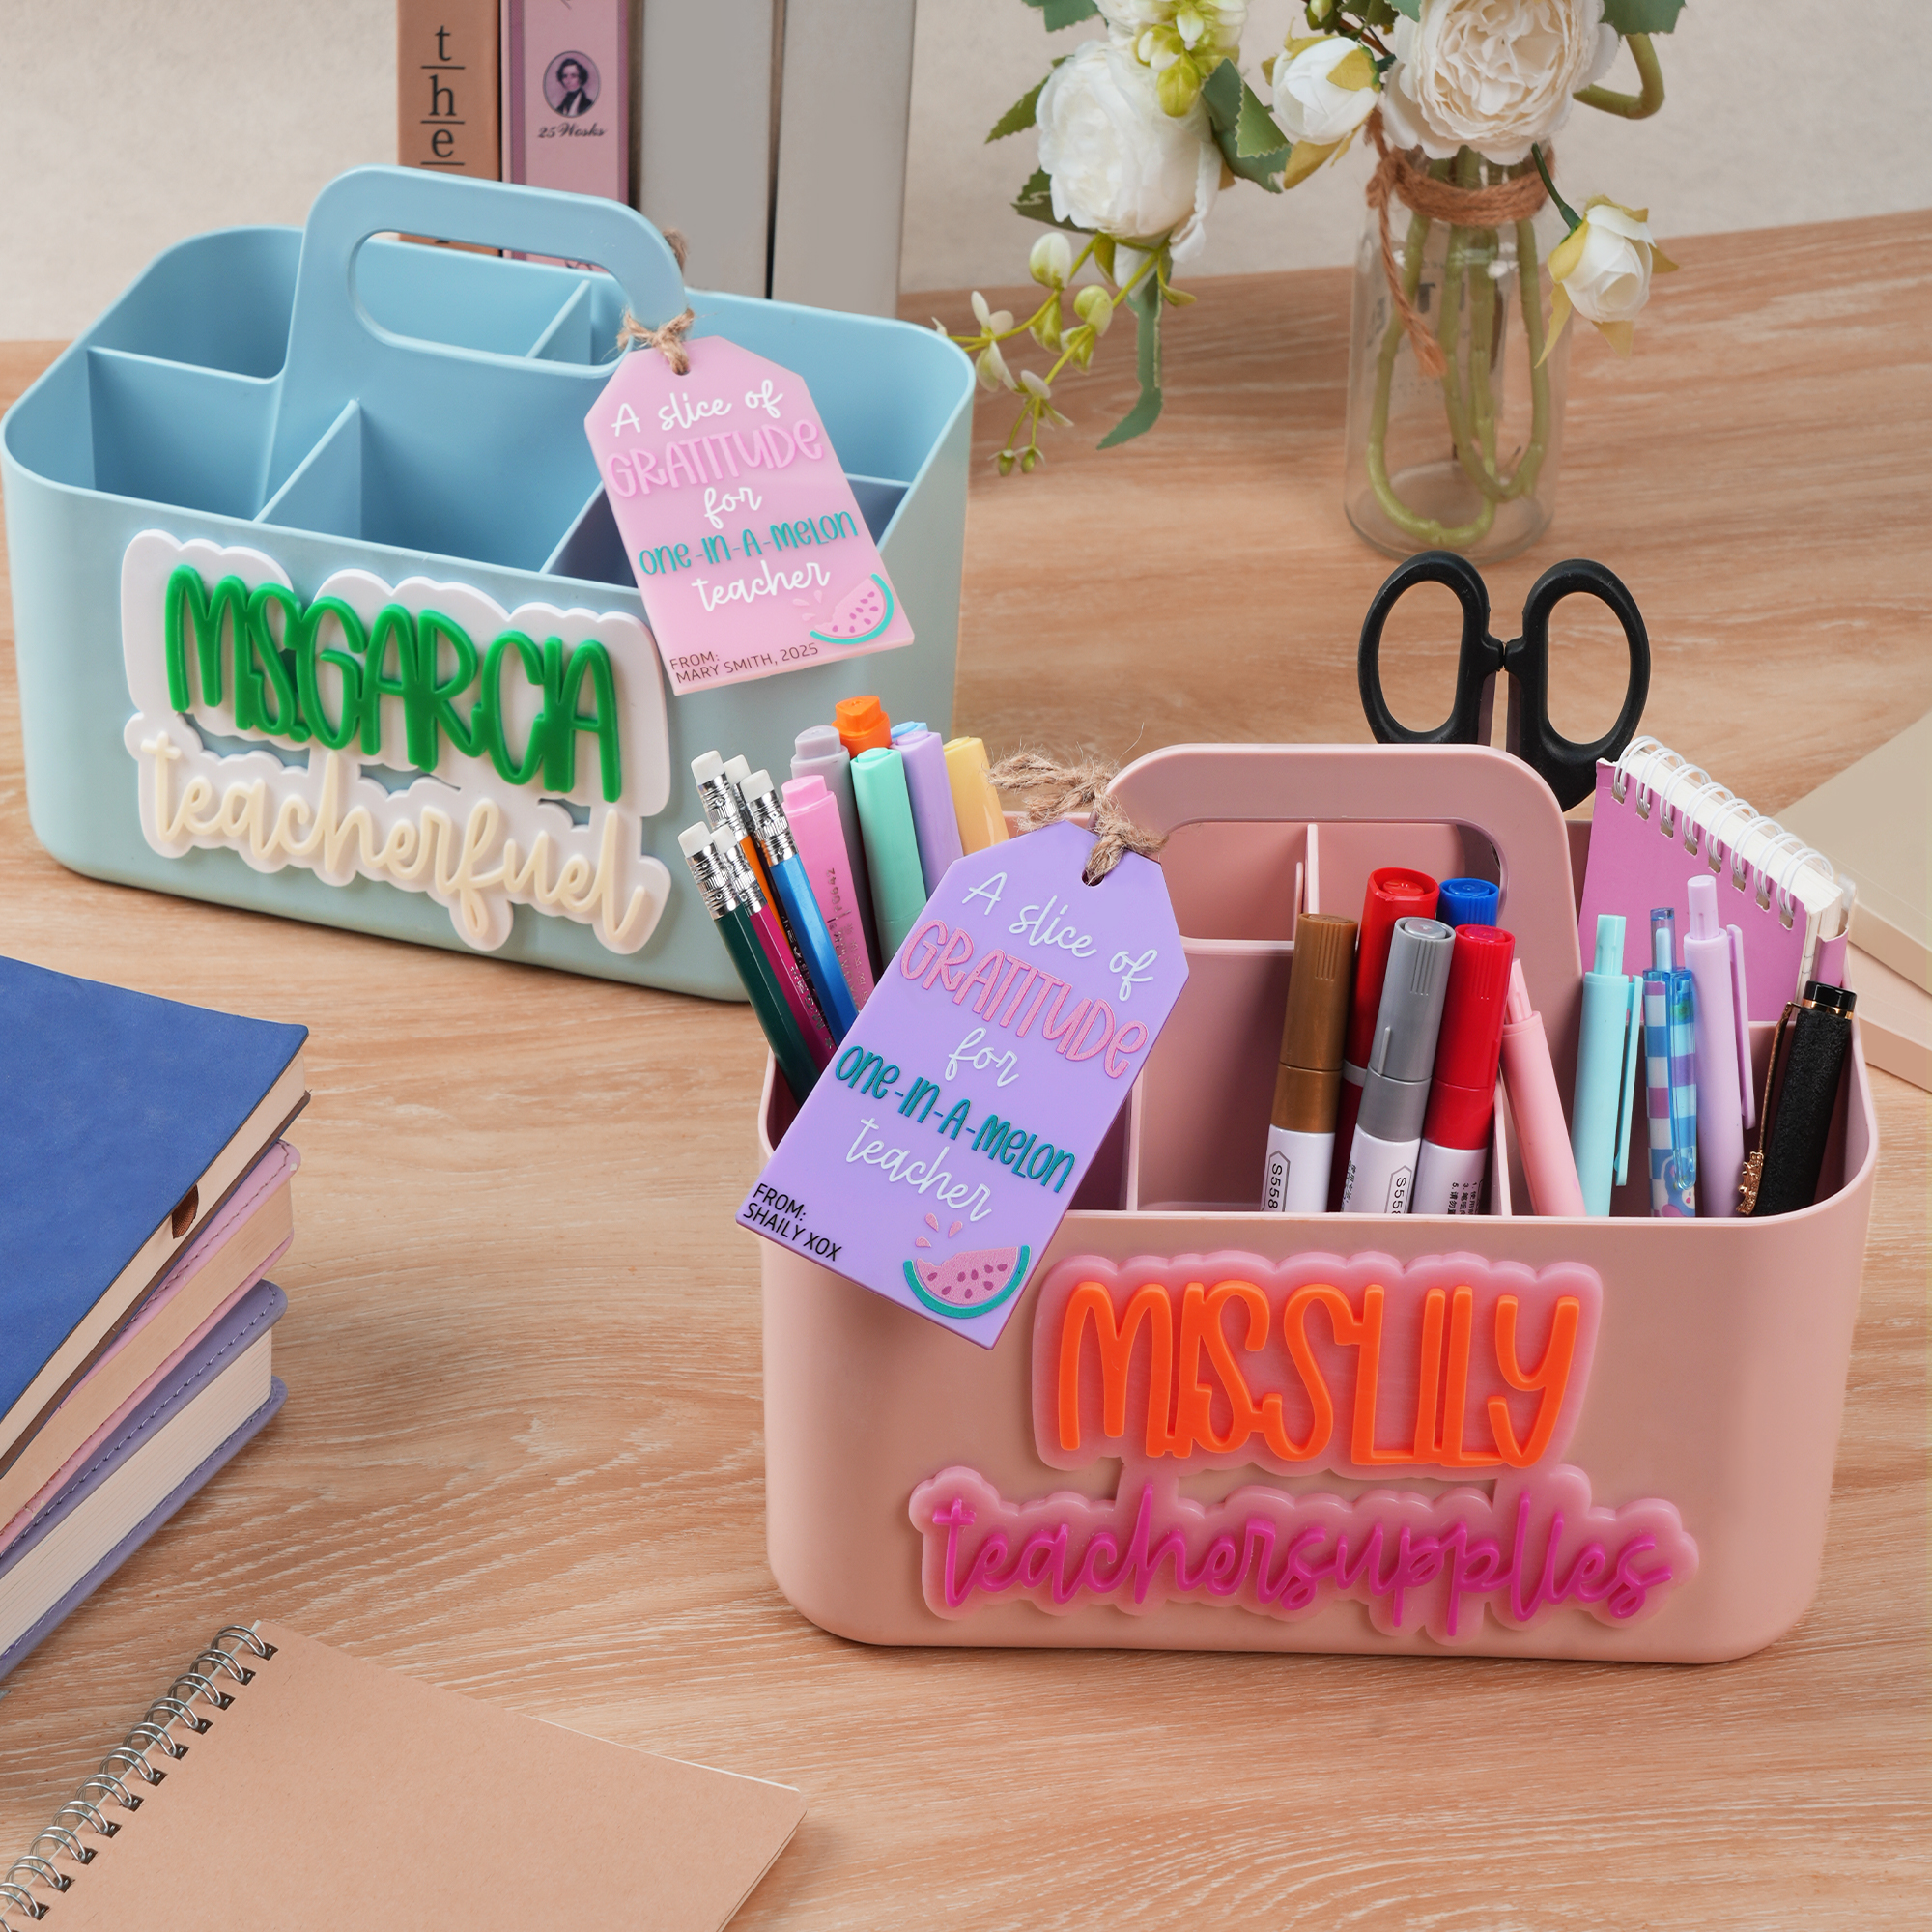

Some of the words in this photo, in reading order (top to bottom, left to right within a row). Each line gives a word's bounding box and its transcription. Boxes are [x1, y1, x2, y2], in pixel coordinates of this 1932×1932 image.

[611, 402, 641, 437] A
[658, 392, 732, 431] slice
[744, 379, 784, 419] of
[703, 486, 763, 529] for
[691, 559, 830, 611] teacher
[669, 651, 720, 670] FROM:
[676, 664, 719, 684] MARY
[724, 653, 779, 674] SMITH,
[779, 642, 818, 662] 2025
[962, 871, 1008, 916] A
[1009, 896, 1097, 958] slice
[1109, 949, 1158, 1002] of
[945, 1027, 1019, 1088] for
[846, 1118, 993, 1222] teacher
[1267, 1162, 1283, 1210] S558
[753, 1182, 807, 1222] FROM:
[1391, 1177, 1407, 1214] S55
[743, 1202, 807, 1241] SHAILY
[803, 1232, 842, 1262] XOX
